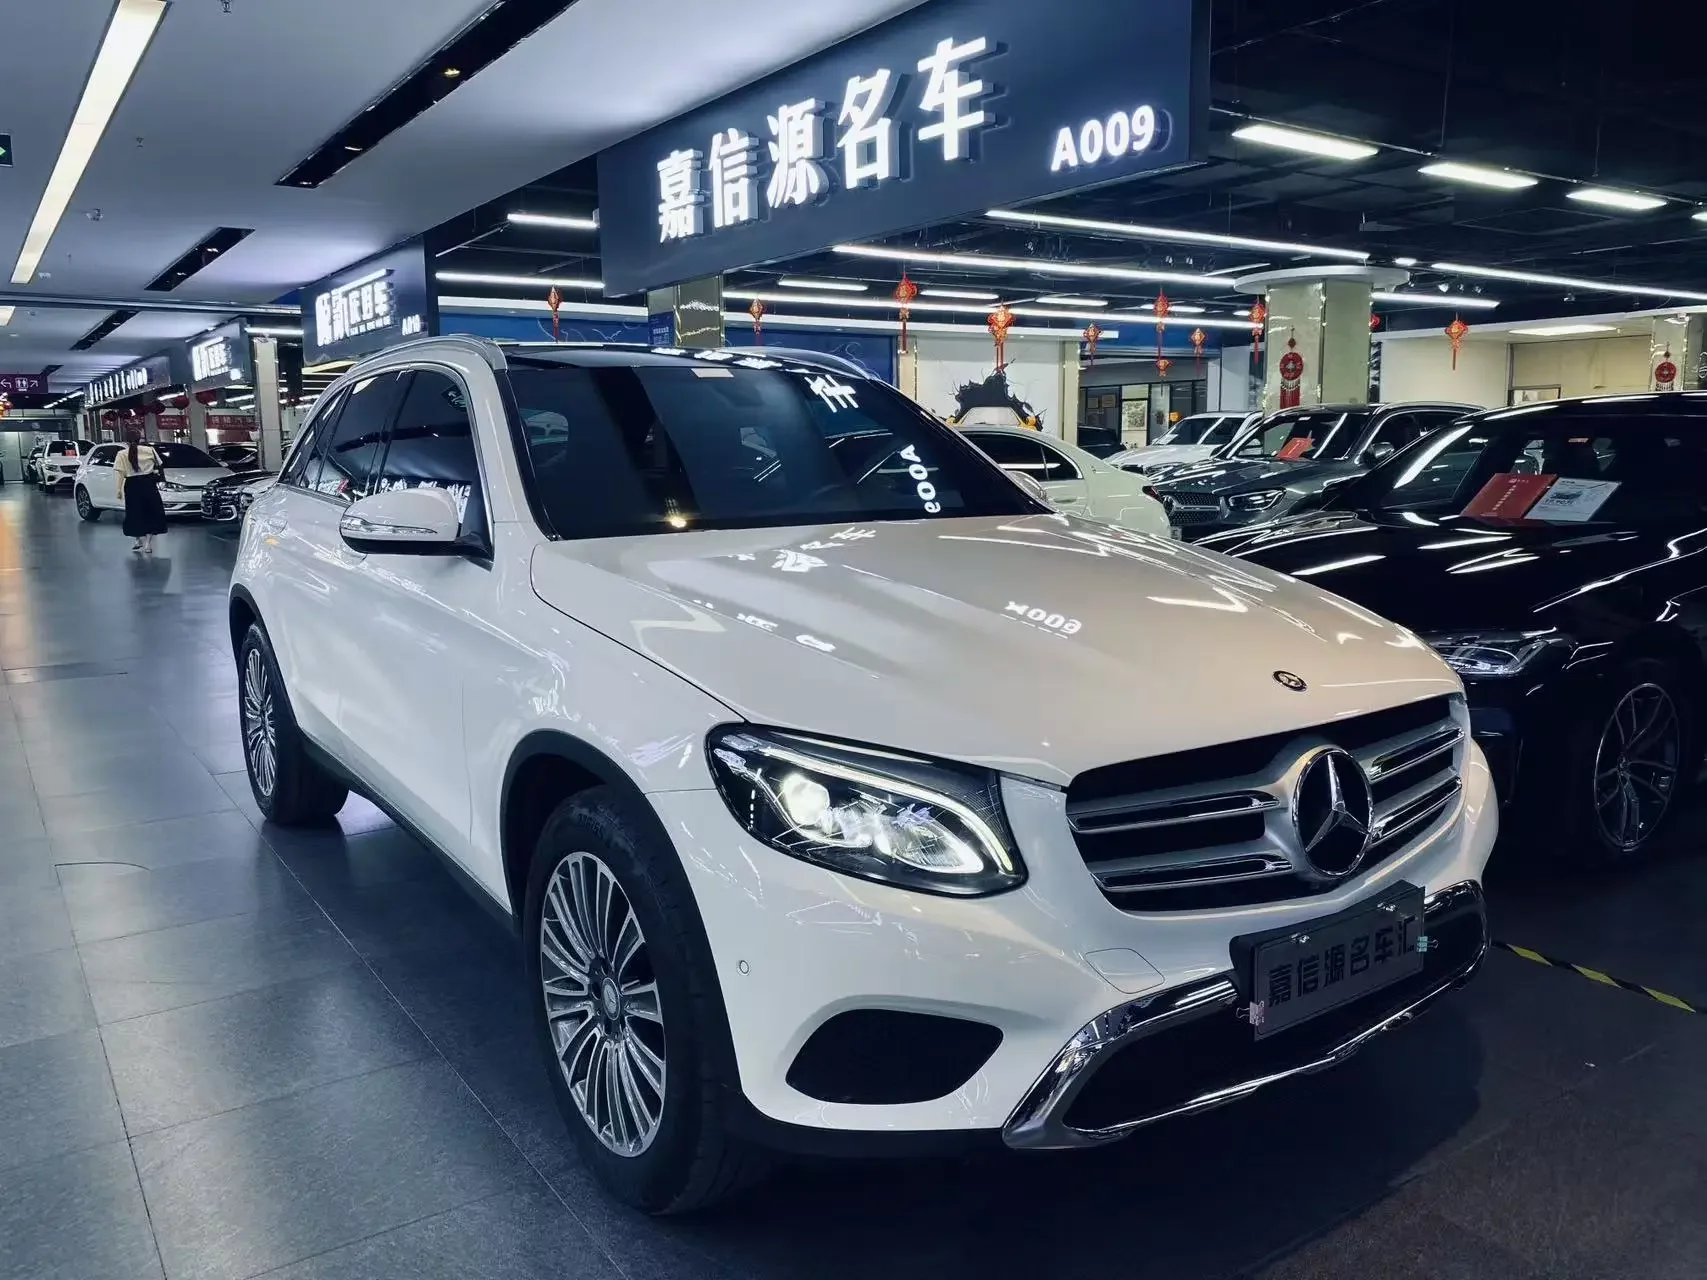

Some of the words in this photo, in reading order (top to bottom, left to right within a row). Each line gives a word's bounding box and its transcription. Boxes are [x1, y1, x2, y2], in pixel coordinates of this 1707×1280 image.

[657, 37, 988, 243] 嘉信源名车
[1051, 104, 1155, 171] A009
[1268, 914, 1418, 1008] 嘉信源名车汇
